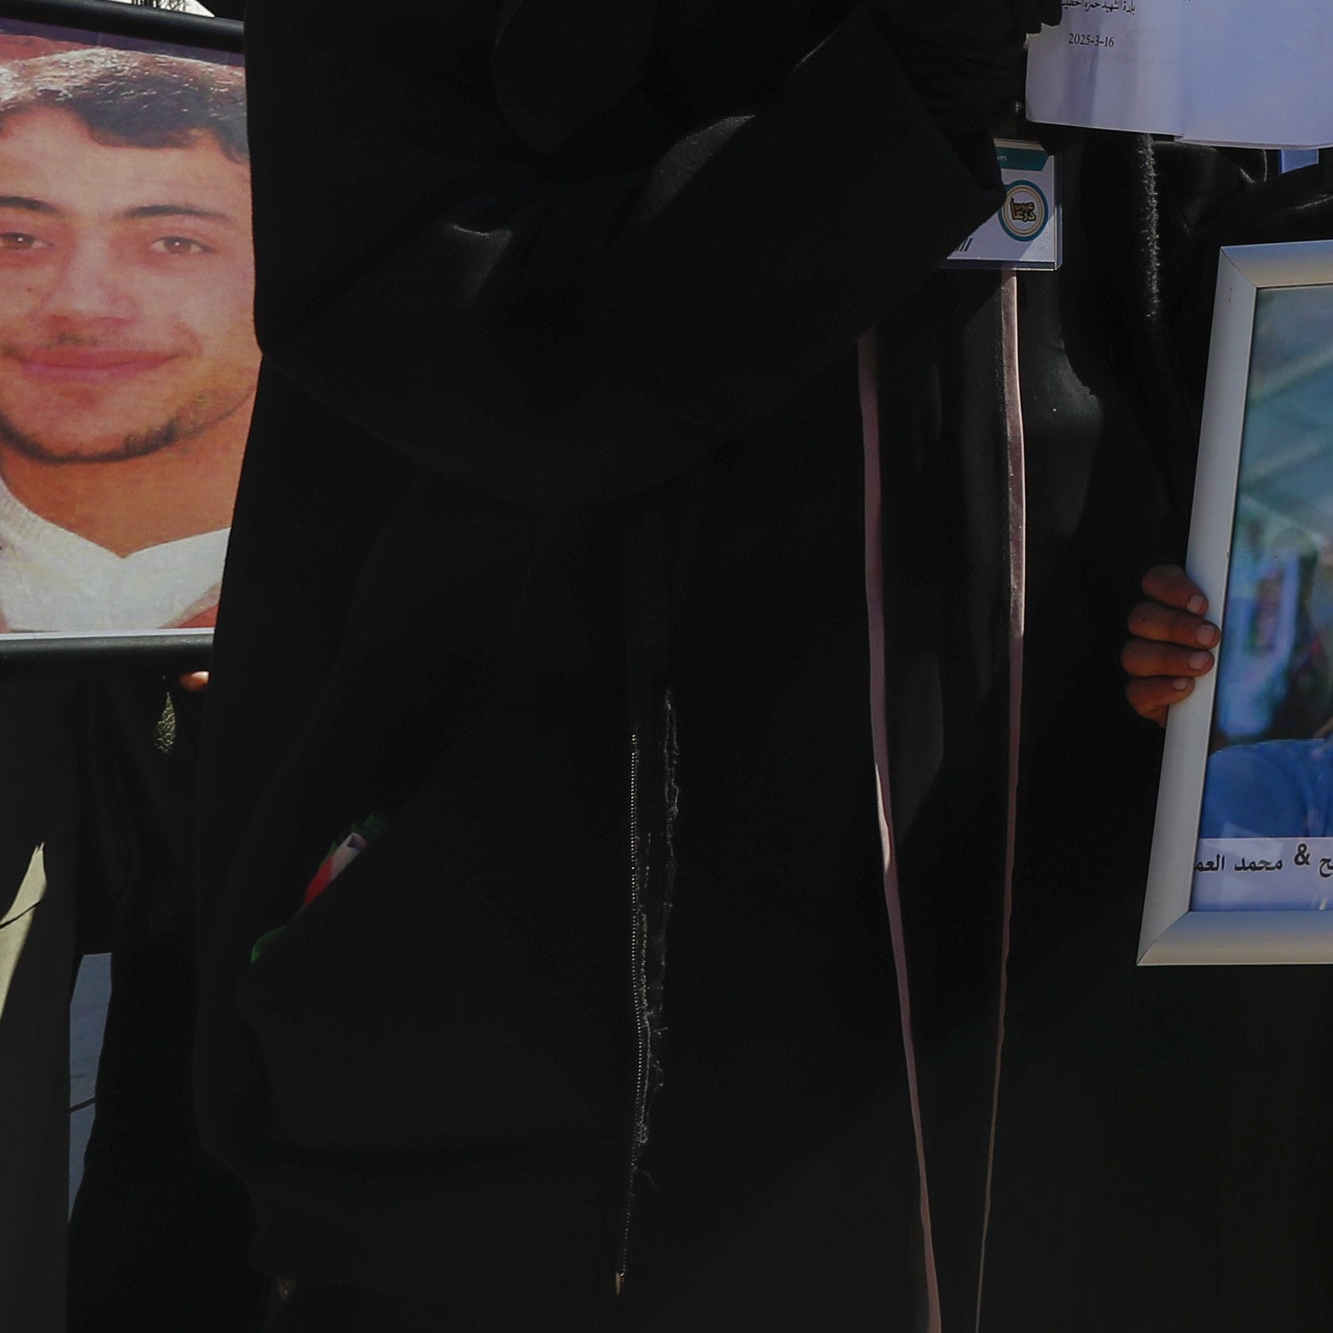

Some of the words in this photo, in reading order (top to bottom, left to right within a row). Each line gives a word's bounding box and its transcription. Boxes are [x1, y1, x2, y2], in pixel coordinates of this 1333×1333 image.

[1068, 32, 1115, 48] 2025-3-16
[1193, 853, 1225, 872] العم
[1293, 843, 1311, 866] &
[1233, 857, 1284, 872] محمد
